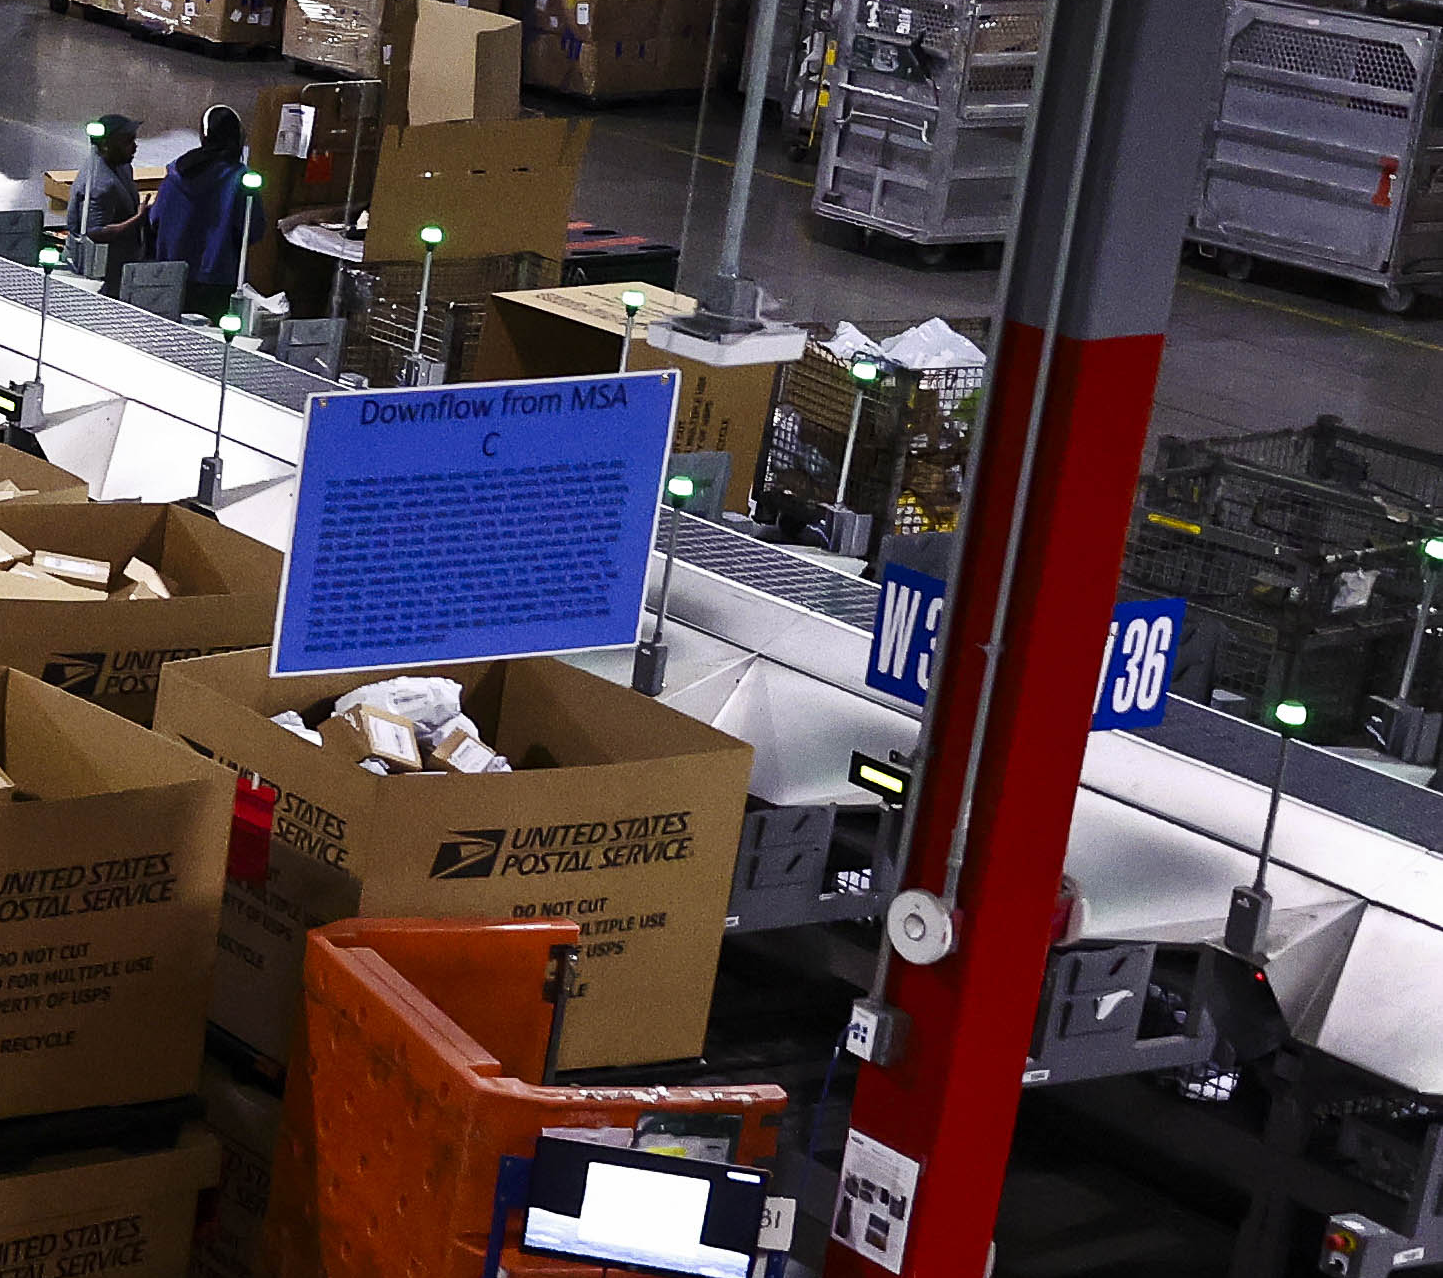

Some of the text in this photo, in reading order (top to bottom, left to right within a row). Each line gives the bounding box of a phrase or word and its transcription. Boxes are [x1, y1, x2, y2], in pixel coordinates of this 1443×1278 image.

[362, 384, 627, 427] Downflow from MSA
[483, 432, 499, 457] C
[877, 581, 922, 680] W
[1112, 616, 1174, 713] 36
